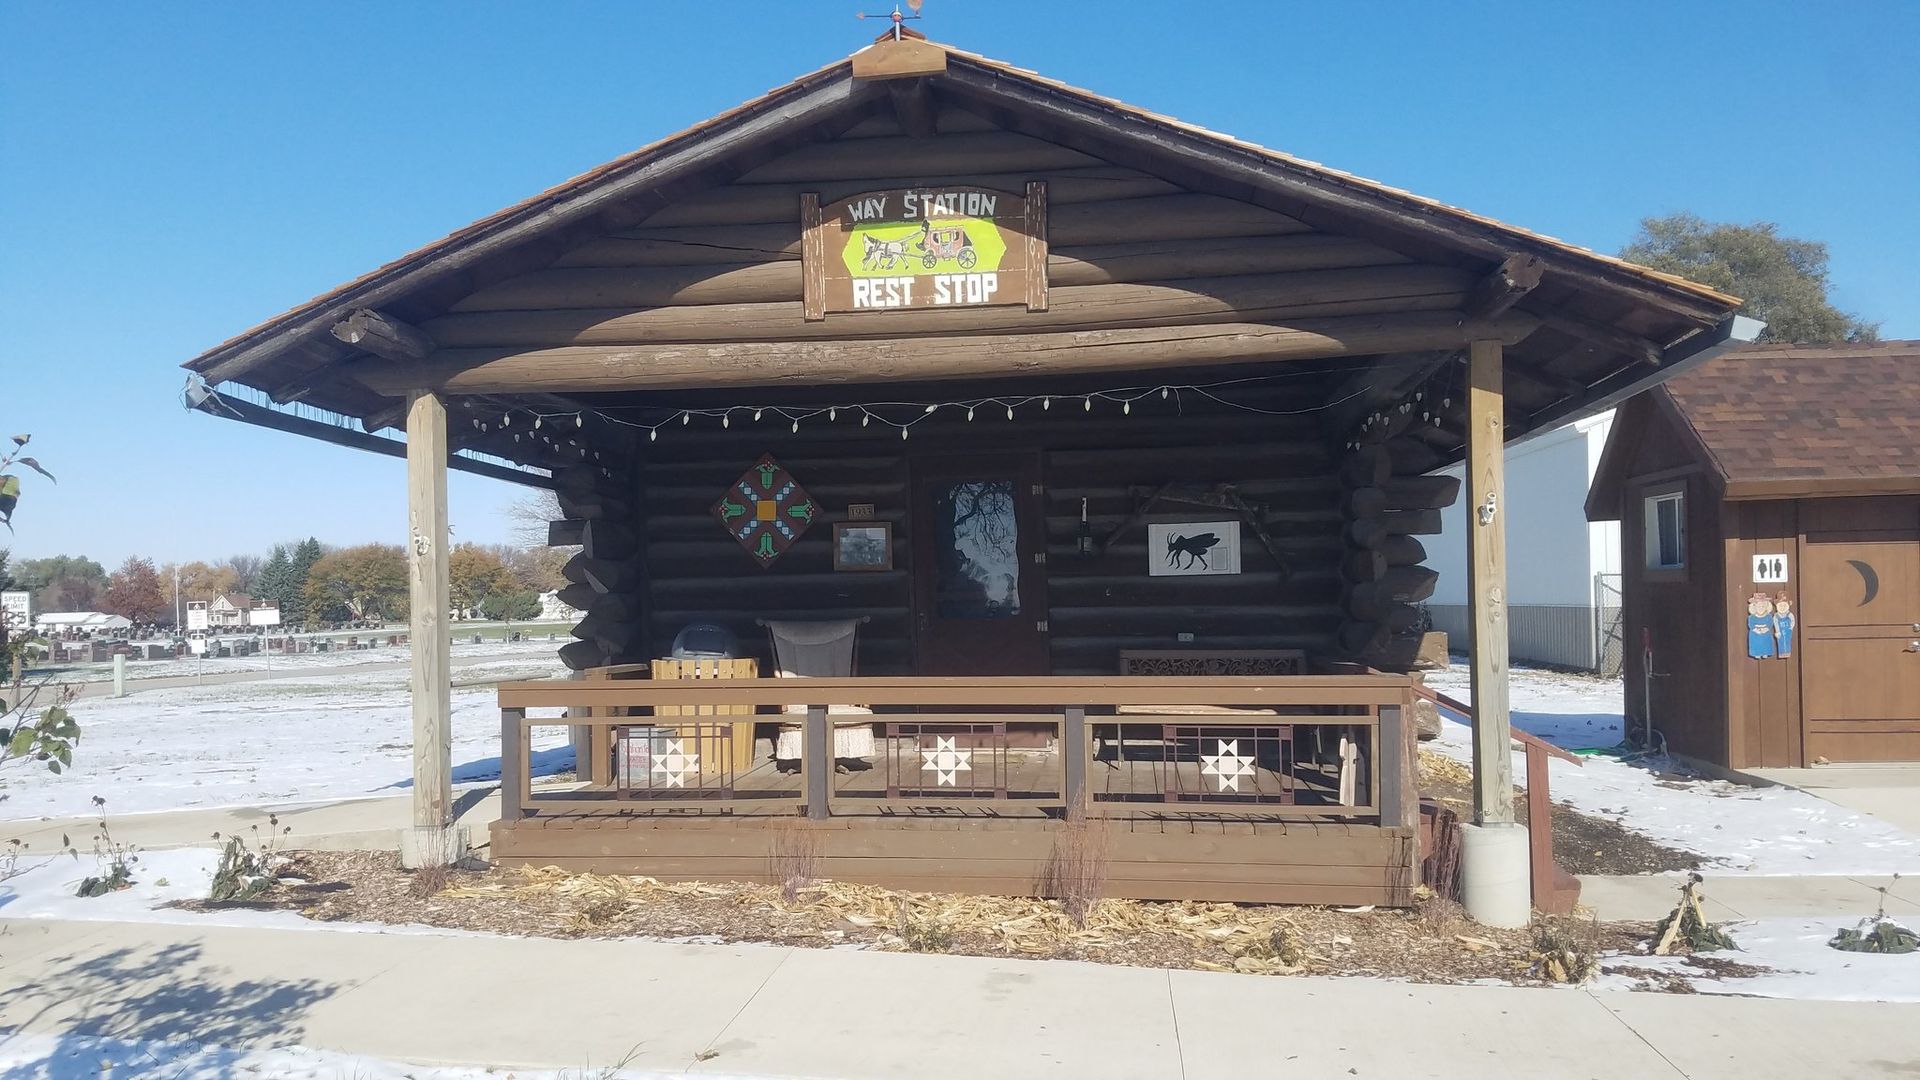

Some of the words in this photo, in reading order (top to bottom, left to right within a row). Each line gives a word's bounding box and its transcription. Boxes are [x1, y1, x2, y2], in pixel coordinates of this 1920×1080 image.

[848, 199, 886, 222] WAY
[904, 192, 996, 218] STATION
[853, 277, 915, 308] REST
[934, 273, 998, 304] STOP
